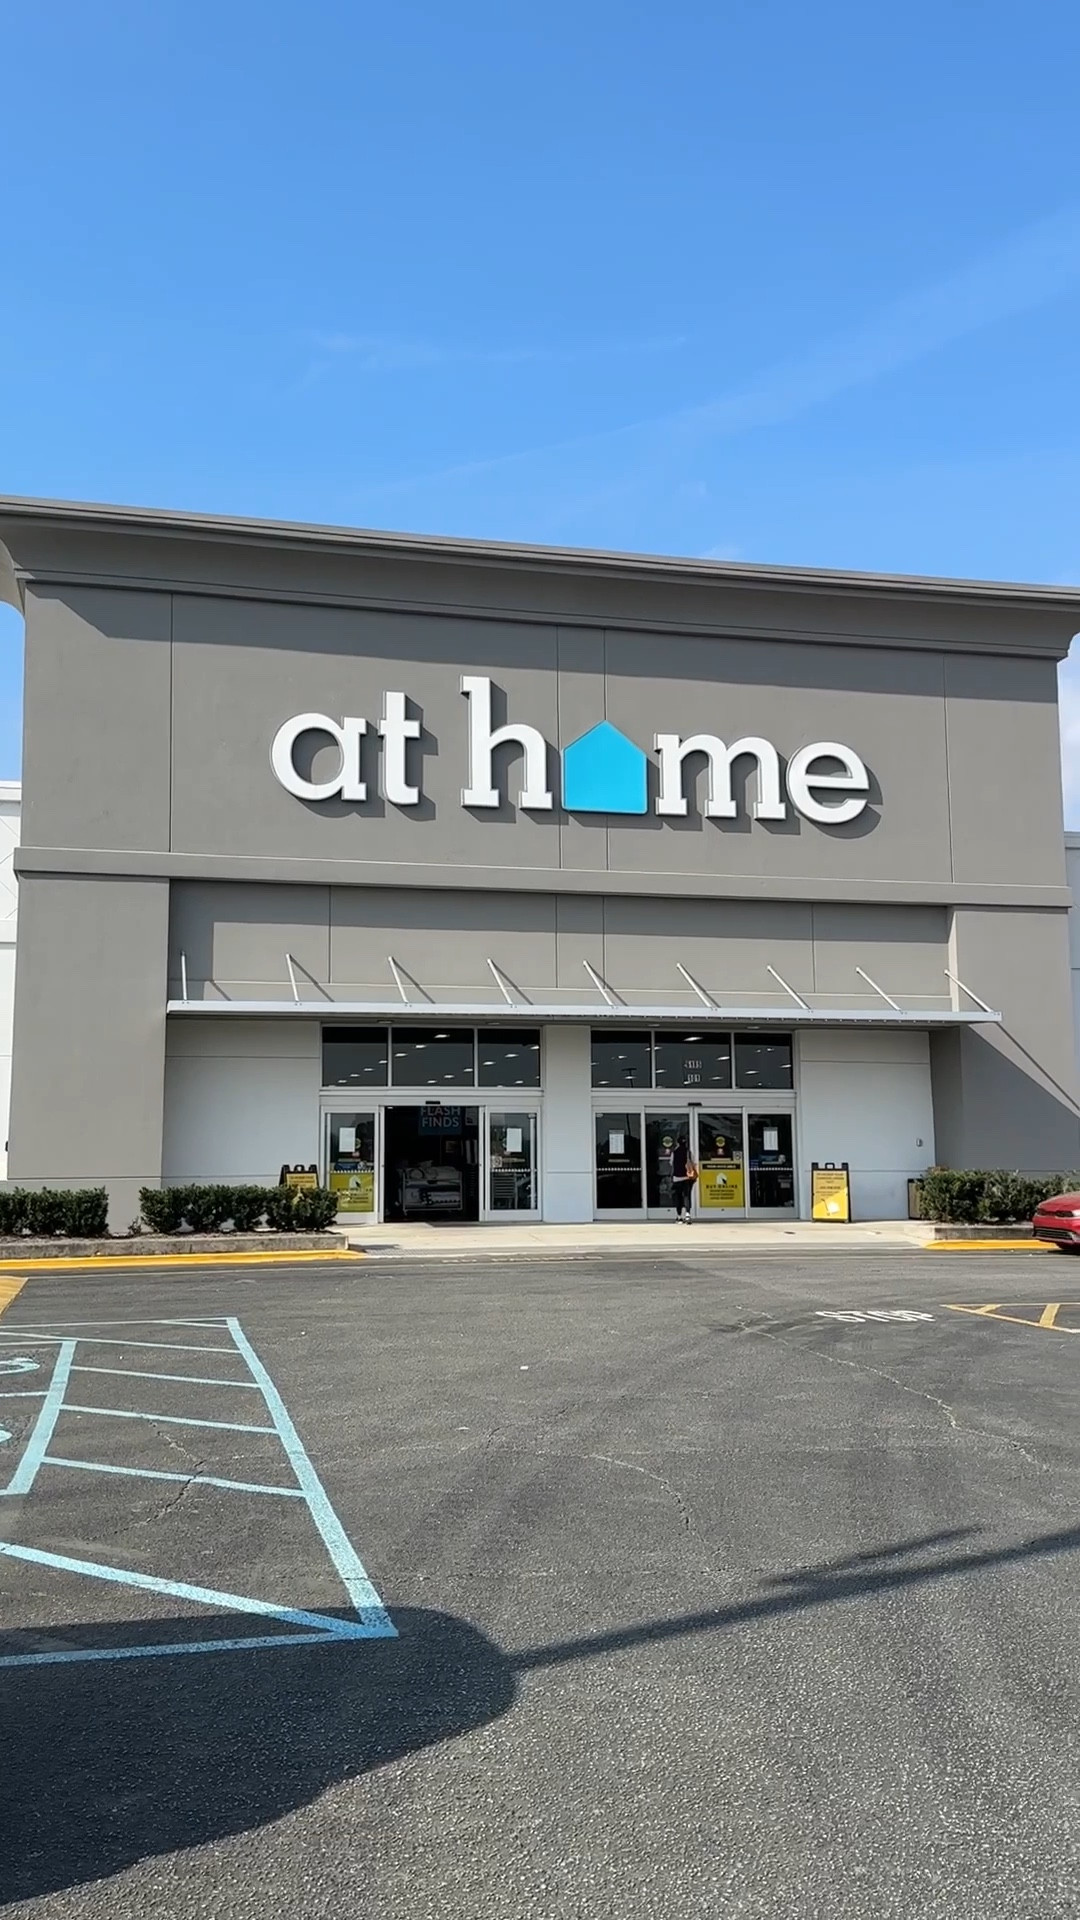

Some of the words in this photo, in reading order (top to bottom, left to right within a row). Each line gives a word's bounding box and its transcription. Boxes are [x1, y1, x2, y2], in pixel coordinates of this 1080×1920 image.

[270, 691, 420, 806] at
[460, 675, 870, 824] hme
[420, 1106, 461, 1116] FLASH
[421, 1116, 460, 1127] FINDS
[815, 1310, 937, 1323] STOP
